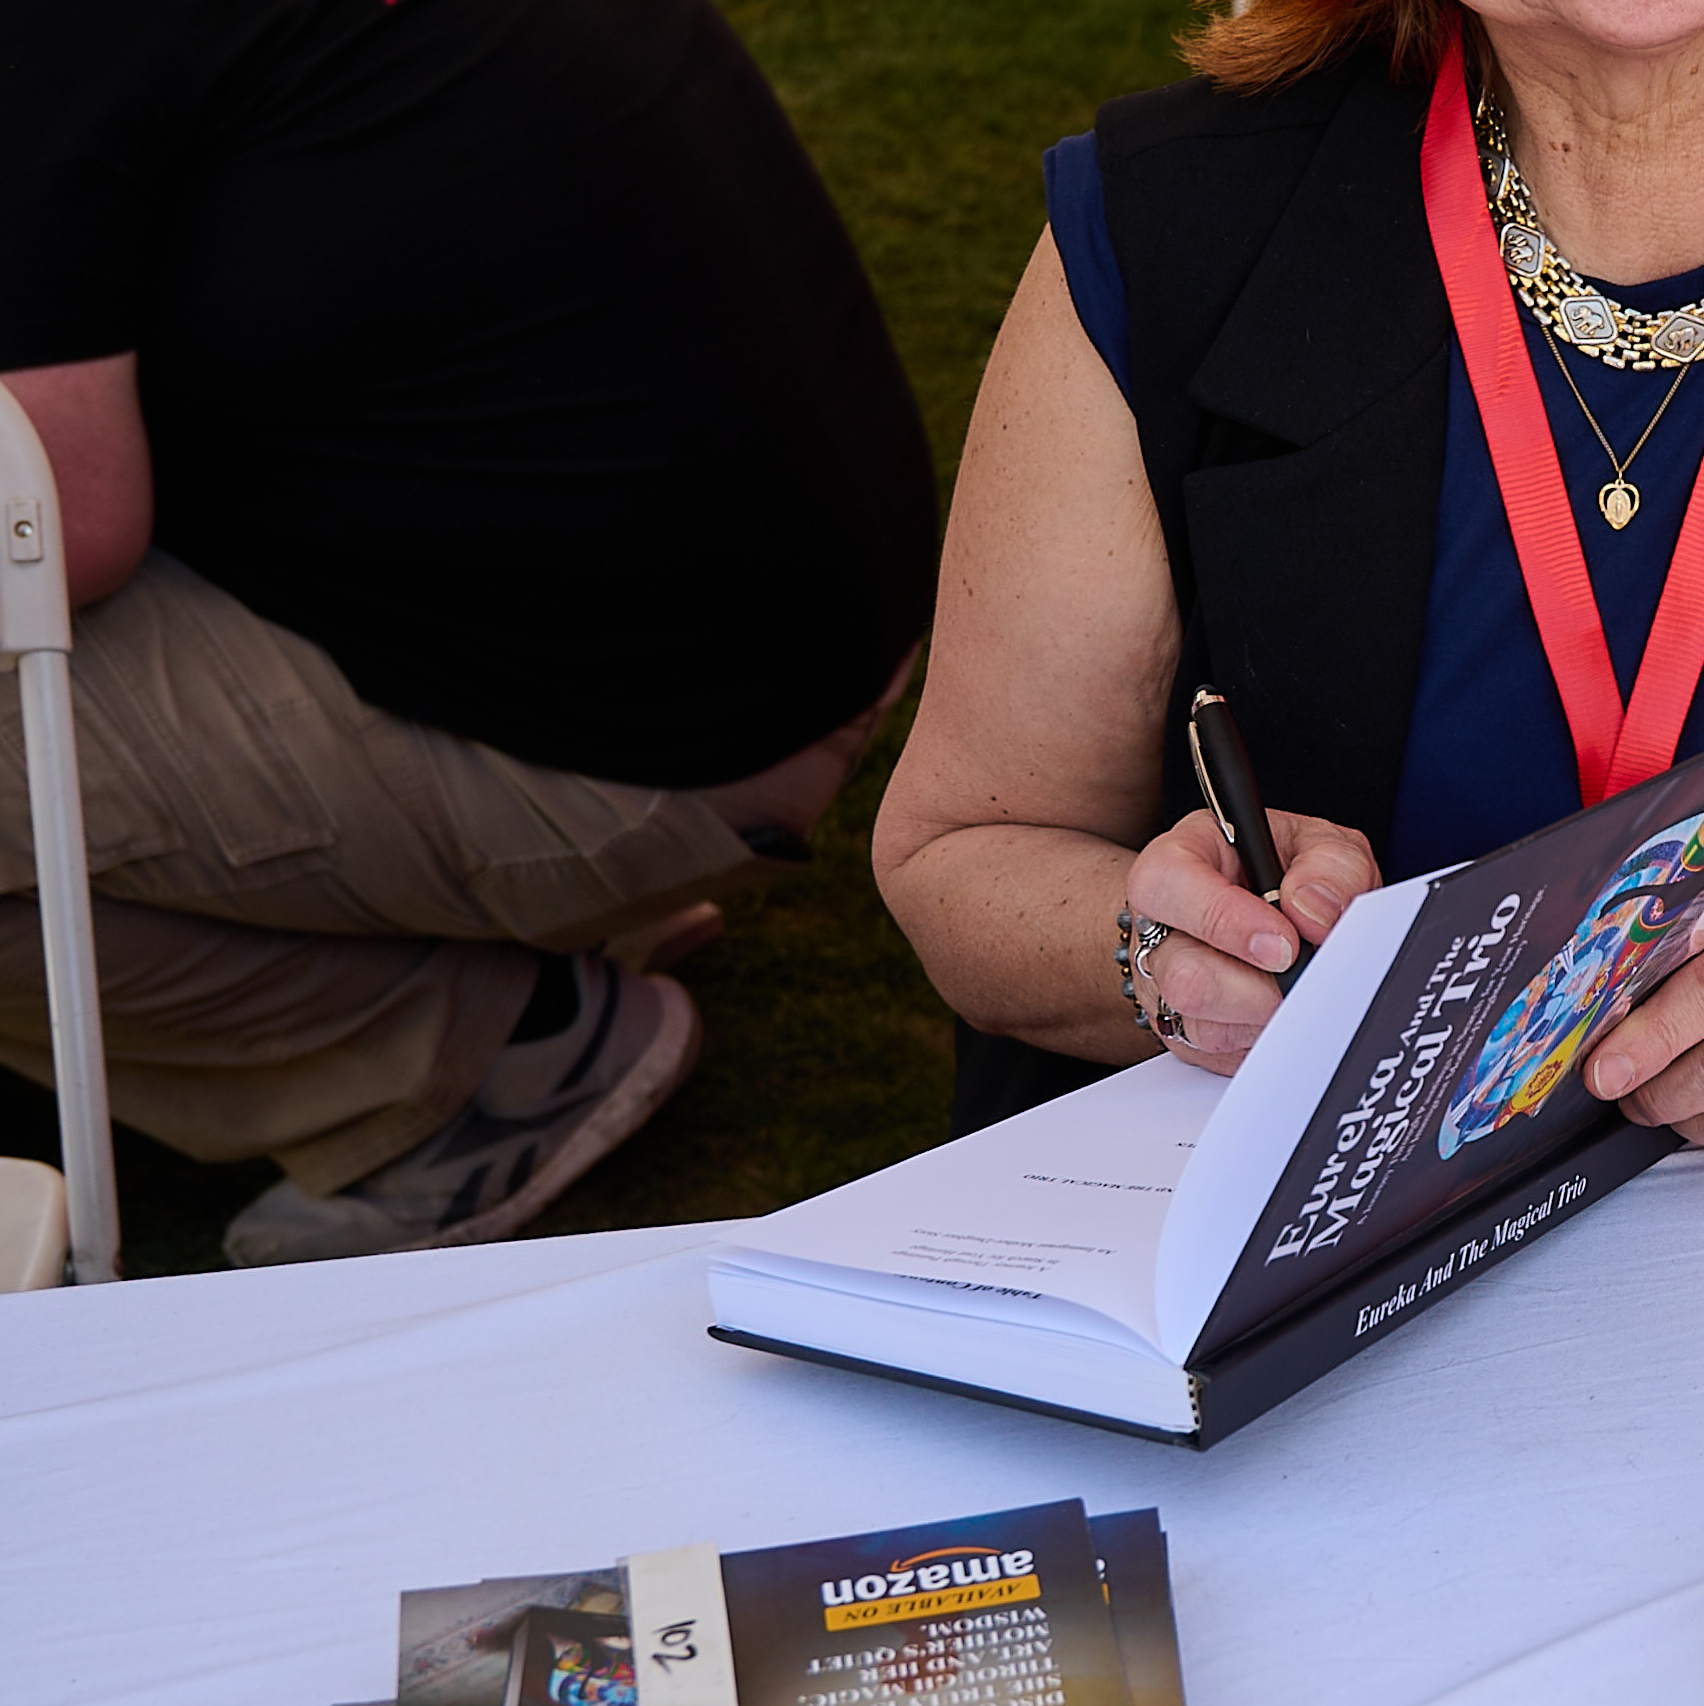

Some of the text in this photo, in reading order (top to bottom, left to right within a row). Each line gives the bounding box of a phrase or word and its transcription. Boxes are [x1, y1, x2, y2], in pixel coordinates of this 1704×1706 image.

[1304, 893, 1521, 1259] Magical Trio
[1265, 935, 1465, 1266] Eureka And The
[1022, 1173, 1054, 1184] TRIO
[1354, 1174, 1588, 1338] Eureka And The Magical Trio
[972, 1282, 995, 1294] of
[1000, 1284, 1043, 1299] Table
[821, 1548, 1035, 1607] amazon
[842, 1582, 1022, 1624] AVAILABLE ON
[919, 1606, 1047, 1638] WISDOM.
[806, 1622, 1050, 1676] MOTHER'S QUIET
[927, 1651, 985, 1672] AND
[859, 1661, 919, 1683] HER
[914, 1657, 1059, 1693] THROUGH
[1008, 1673, 1062, 1694] SHE
